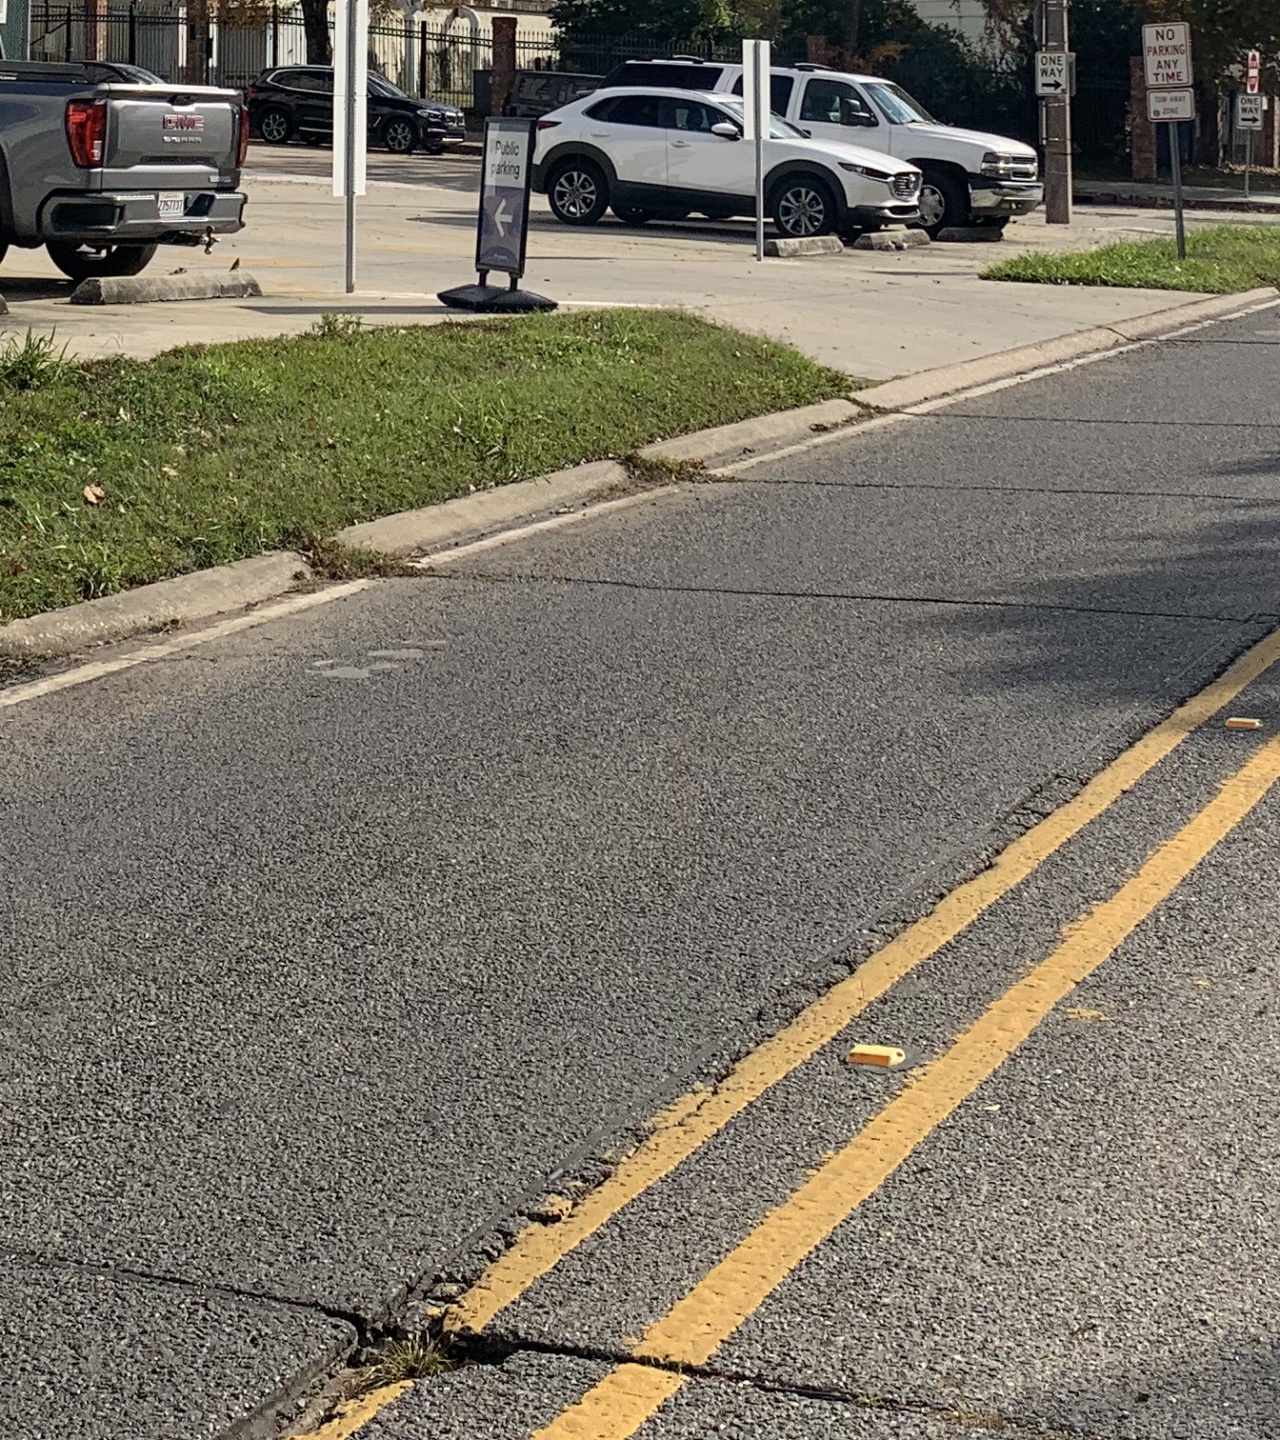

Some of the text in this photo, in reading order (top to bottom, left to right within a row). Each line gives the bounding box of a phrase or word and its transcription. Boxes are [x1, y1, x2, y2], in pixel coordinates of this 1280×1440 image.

[1156, 28, 1175, 41] NO
[1147, 44, 1185, 56] PARKING
[1040, 55, 1064, 66] ONE
[1157, 59, 1179, 70] ANY
[1040, 67, 1064, 78] WAY
[1153, 71, 1183, 82] TIME
[1240, 97, 1259, 105] ONE
[1240, 106, 1259, 114] WAY
[163, 114, 205, 131] GMC
[495, 140, 520, 156] Public
[491, 160, 520, 180] parking
